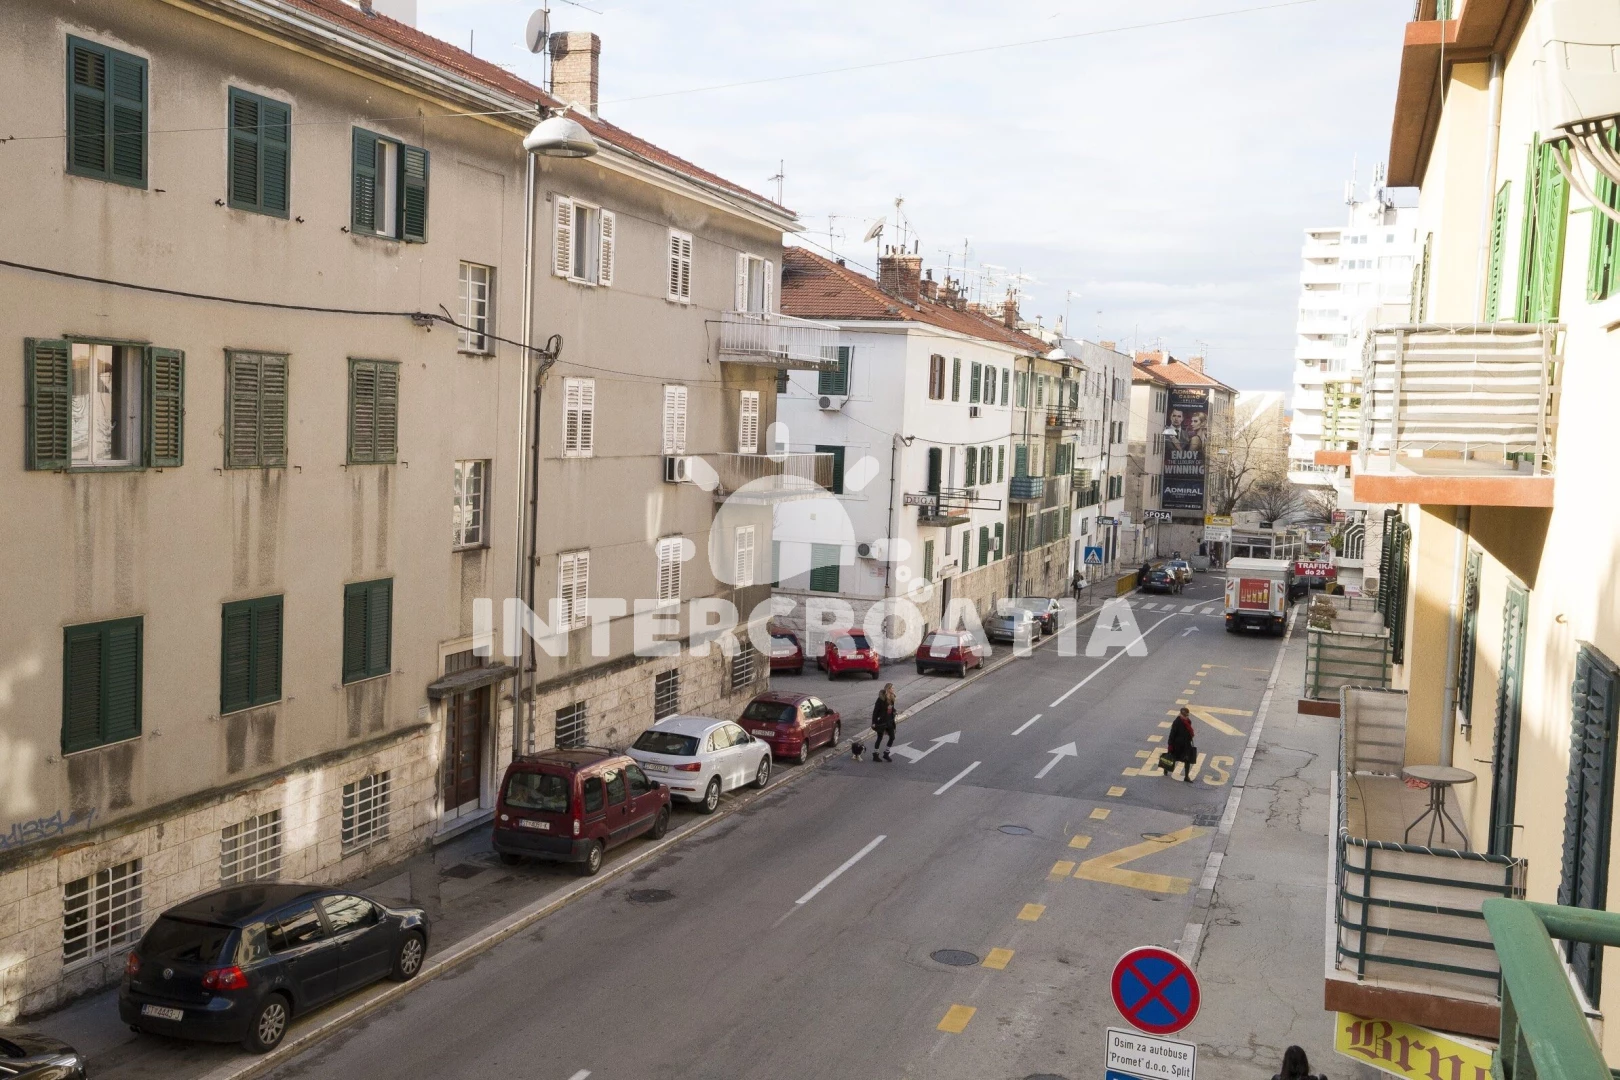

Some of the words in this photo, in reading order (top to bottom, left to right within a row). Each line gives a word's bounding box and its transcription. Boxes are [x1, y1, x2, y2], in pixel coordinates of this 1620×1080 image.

[1172, 388, 1206, 396] ADMIRAL
[1171, 450, 1199, 460] ENJOY
[1164, 464, 1205, 475] WINNING
[1164, 486, 1203, 495] ADMIRAL
[906, 496, 935, 505] DUGA
[1144, 511, 1171, 519] SPOSA
[1297, 562, 1334, 570] TRAFIKA
[1114, 1036, 1134, 1050] Osim
[1136, 1043, 1147, 1053] za
[1149, 1045, 1188, 1060] autobuse
[1145, 1059, 1169, 1074] d.o.o.
[1171, 1064, 1190, 1078] Split
